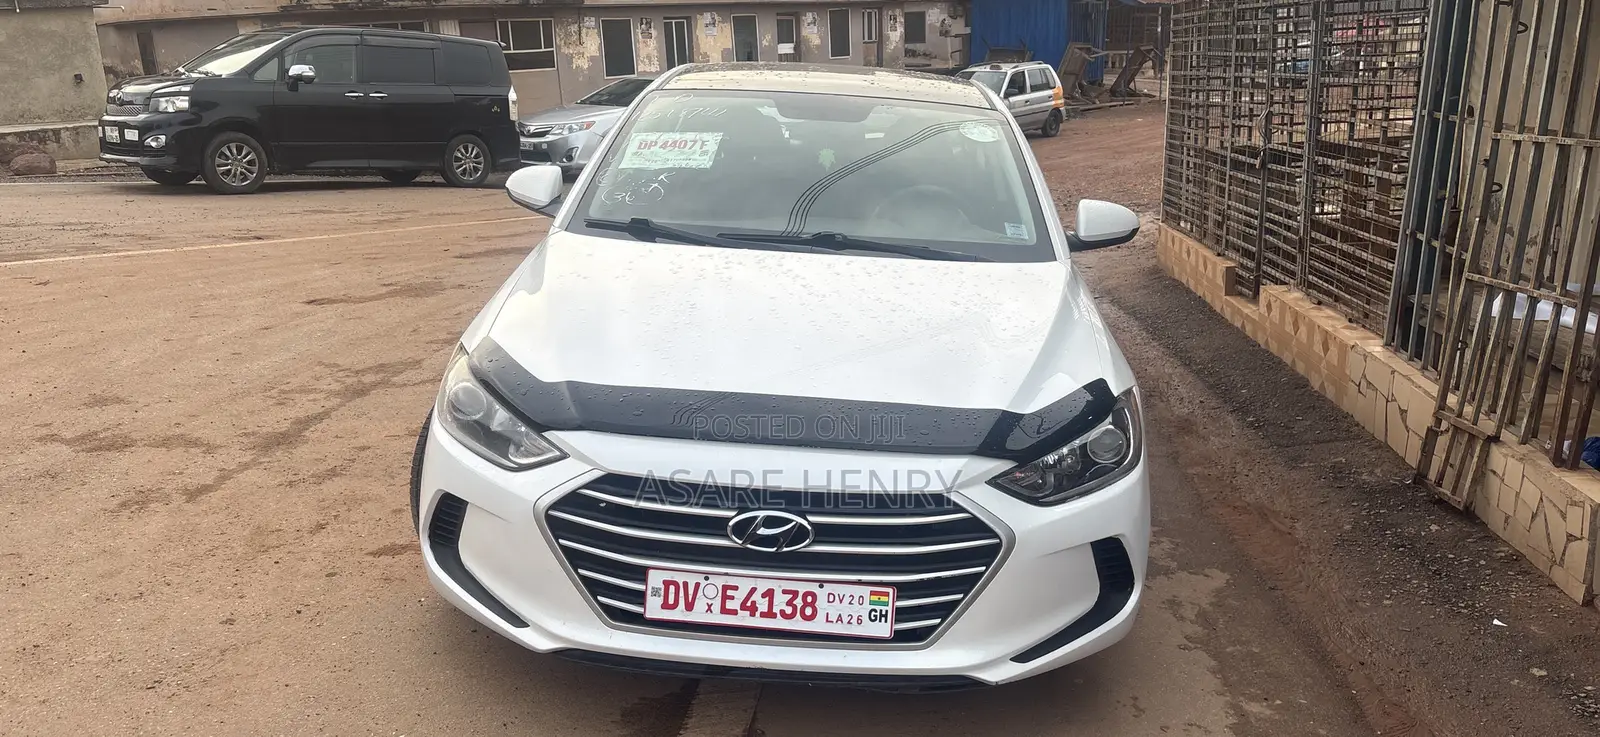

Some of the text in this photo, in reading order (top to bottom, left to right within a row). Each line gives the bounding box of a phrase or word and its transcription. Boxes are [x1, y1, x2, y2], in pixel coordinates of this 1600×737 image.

[637, 140, 658, 150] DP
[659, 139, 698, 150] 4407
[660, 578, 701, 612] DV
[719, 583, 818, 621] E4138
[827, 592, 864, 606] DV20
[825, 612, 863, 625] LA26
[868, 608, 889, 624] GH
